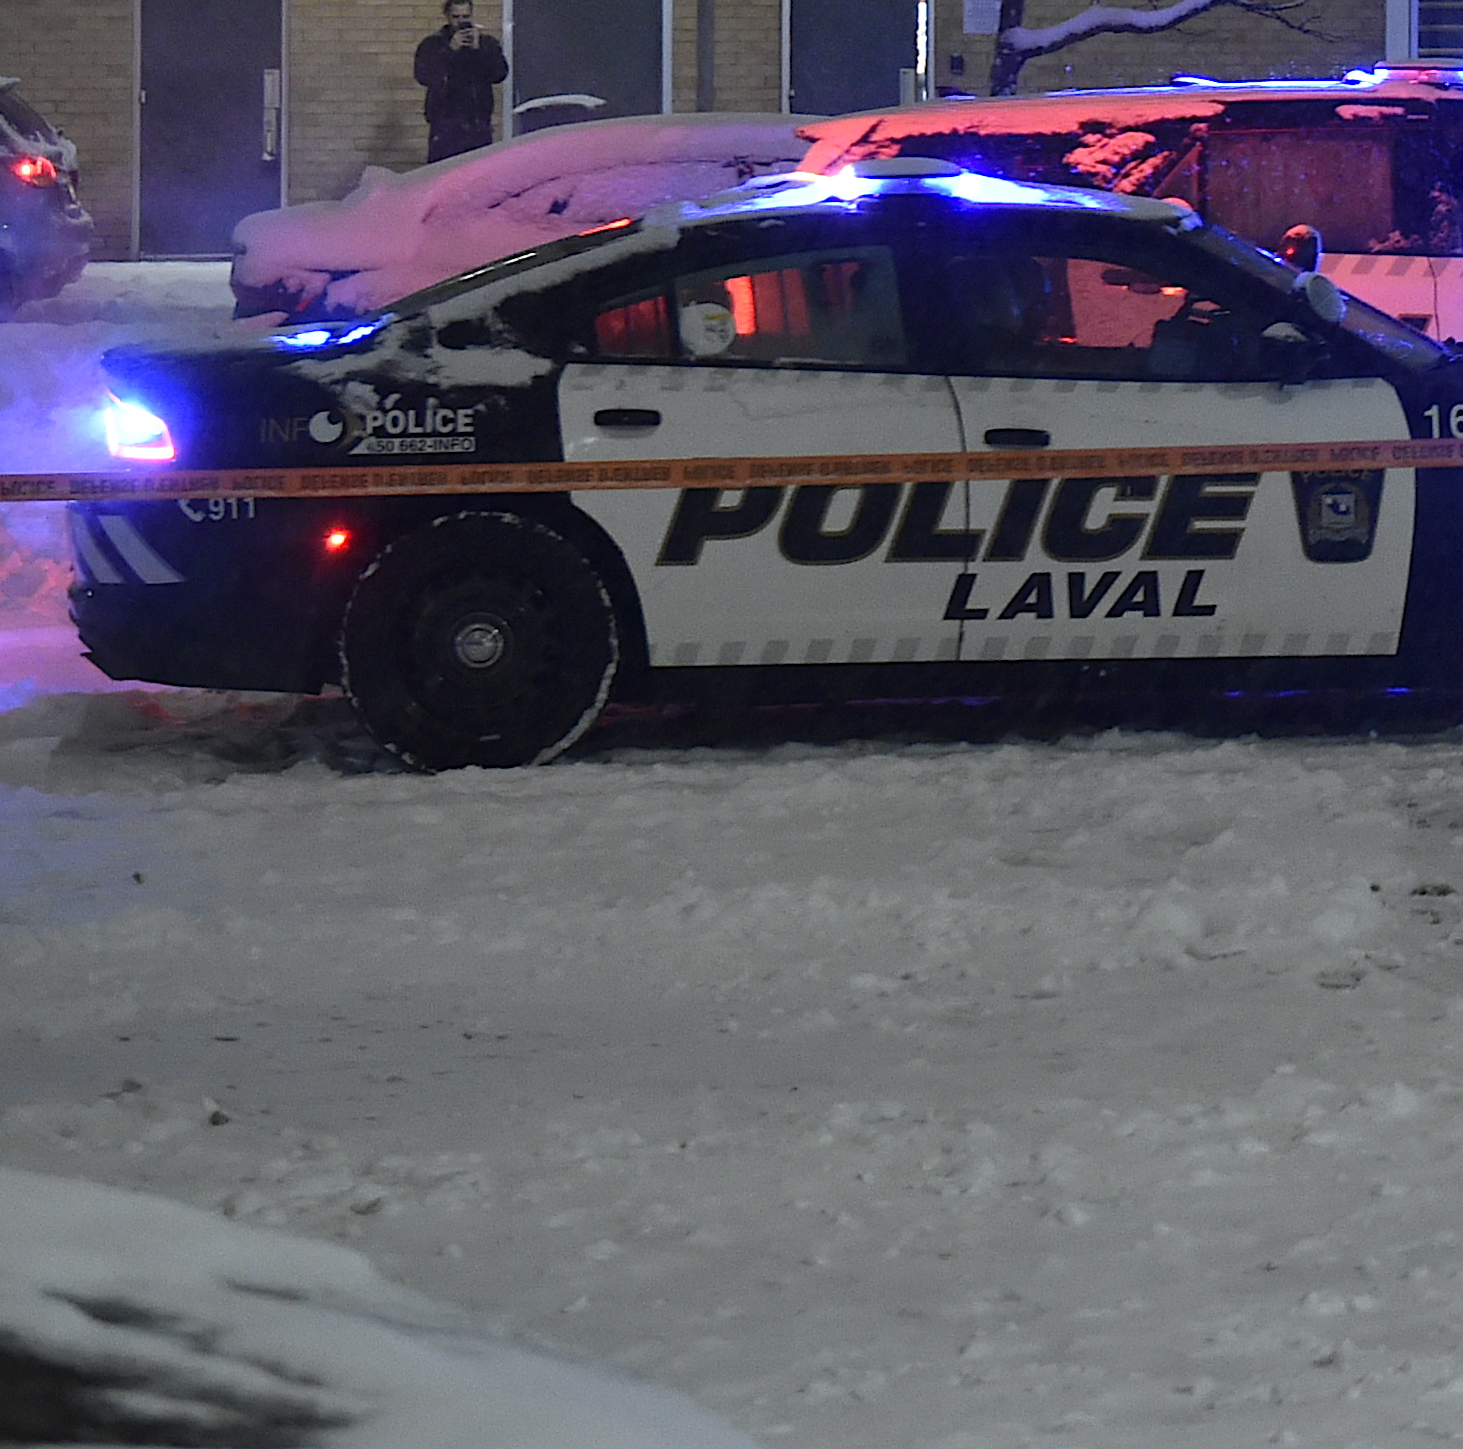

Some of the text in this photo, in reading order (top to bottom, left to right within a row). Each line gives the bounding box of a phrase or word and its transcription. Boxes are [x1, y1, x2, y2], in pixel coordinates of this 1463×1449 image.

[366, 408, 475, 435] POLICE
[400, 436, 473, 451] 662-INFO
[209, 497, 255, 519] 911
[656, 473, 1258, 564] POLICE
[943, 568, 1220, 620] LAVAL
